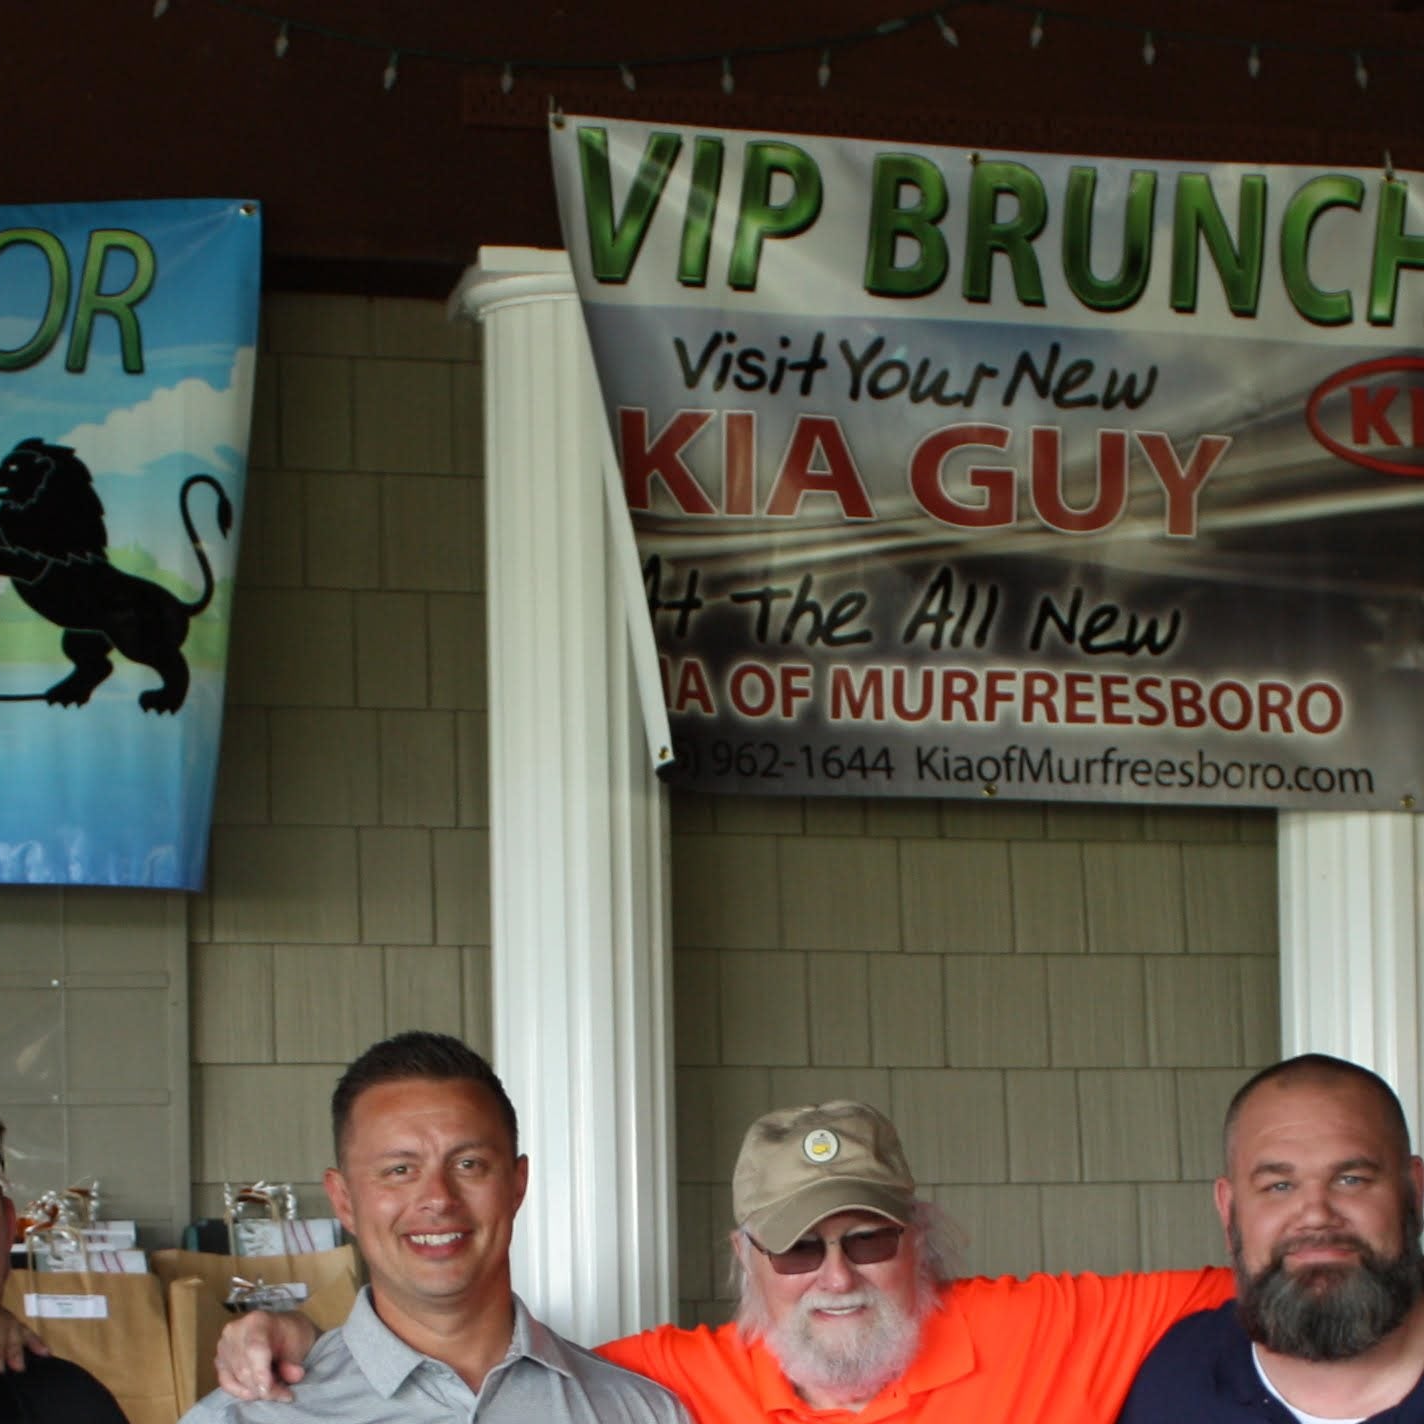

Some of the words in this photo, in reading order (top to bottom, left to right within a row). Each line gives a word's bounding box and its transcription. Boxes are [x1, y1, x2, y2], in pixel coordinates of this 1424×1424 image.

[578, 126, 824, 291] VIP
[674, 332, 825, 396] Visit
[841, 337, 998, 408] Your
[1004, 343, 1158, 411] New
[618, 408, 877, 521] KIA
[908, 423, 1233, 538] GUY
[644, 554, 703, 639] At
[730, 573, 873, 646] The
[905, 567, 999, 650] All
[1030, 599, 1182, 657] New
[729, 660, 813, 719] OF
[830, 663, 1344, 735] MURFREESBORO
[712, 740, 895, 780] 962-1644
[915, 746, 1375, 795] KiaofMurfreesboro.com
